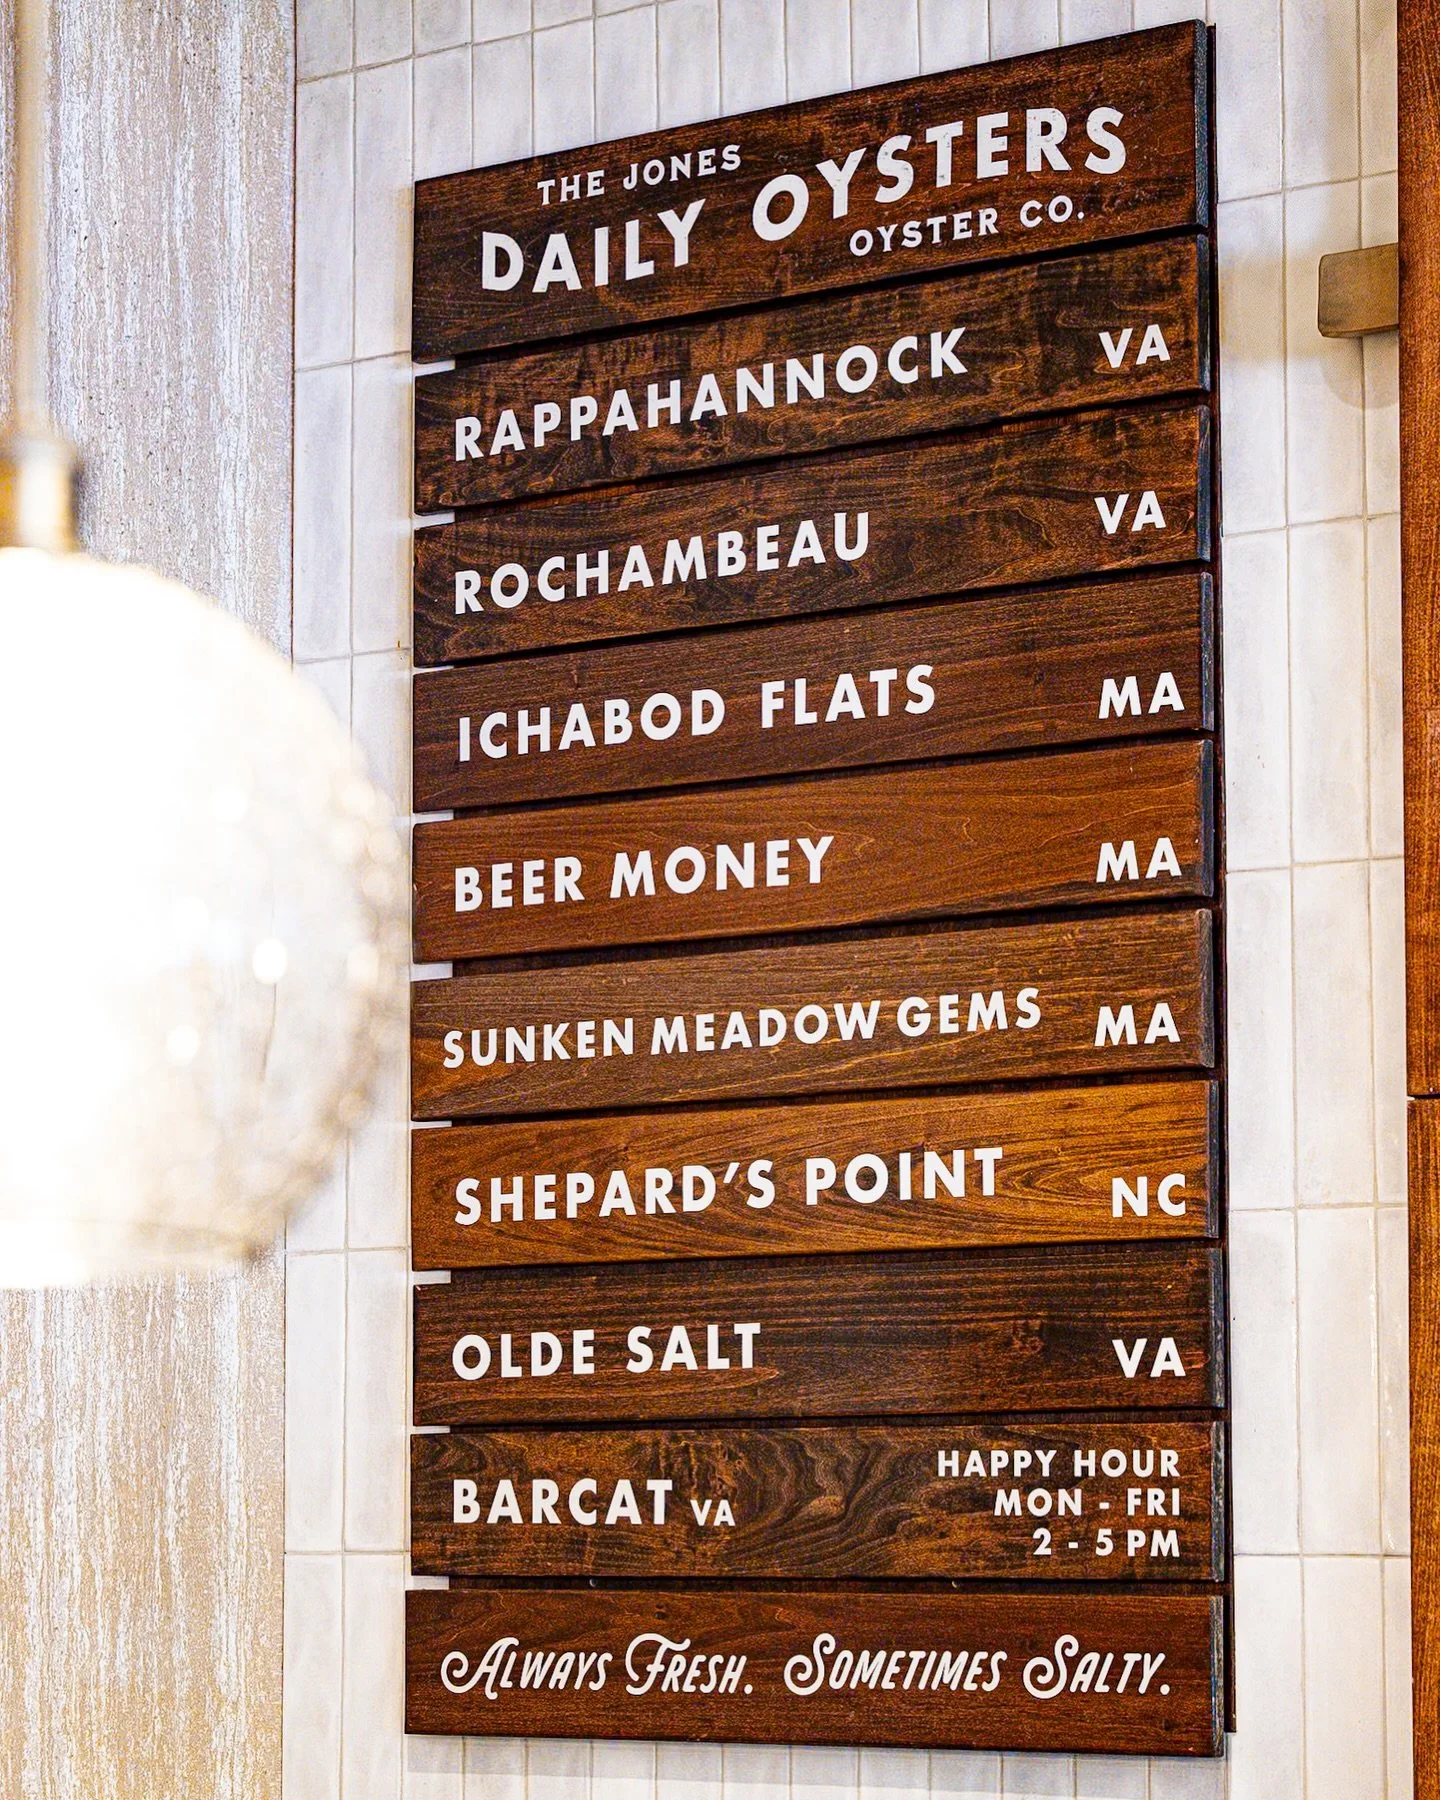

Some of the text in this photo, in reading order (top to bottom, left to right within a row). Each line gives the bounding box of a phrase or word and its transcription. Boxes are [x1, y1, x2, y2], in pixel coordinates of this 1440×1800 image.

[482, 107, 1125, 293] DAILY OYSTERS
[538, 144, 741, 207] THE JONES
[849, 195, 1085, 257] OYSTER CO.
[456, 324, 1170, 461] RAPPAHANNOCK VA
[456, 491, 1166, 615] ROCHAMBEAU VA
[460, 665, 1184, 762] ICHABOD FLATS MA
[456, 836, 1182, 912] BEER MONEY MA
[444, 988, 1181, 1069] SUNKEN MEADOW GEMS MA
[455, 1147, 1186, 1226] SHEPARD'S POINT NC
[453, 1323, 1185, 1381] OLDE SALT VA
[938, 1449, 1181, 1478] HAPPY HOUR
[454, 1478, 735, 1527] BARCAT VA
[995, 1488, 1180, 1516] MON - FRI
[1033, 1528, 1180, 1558] 2 - 5 PM
